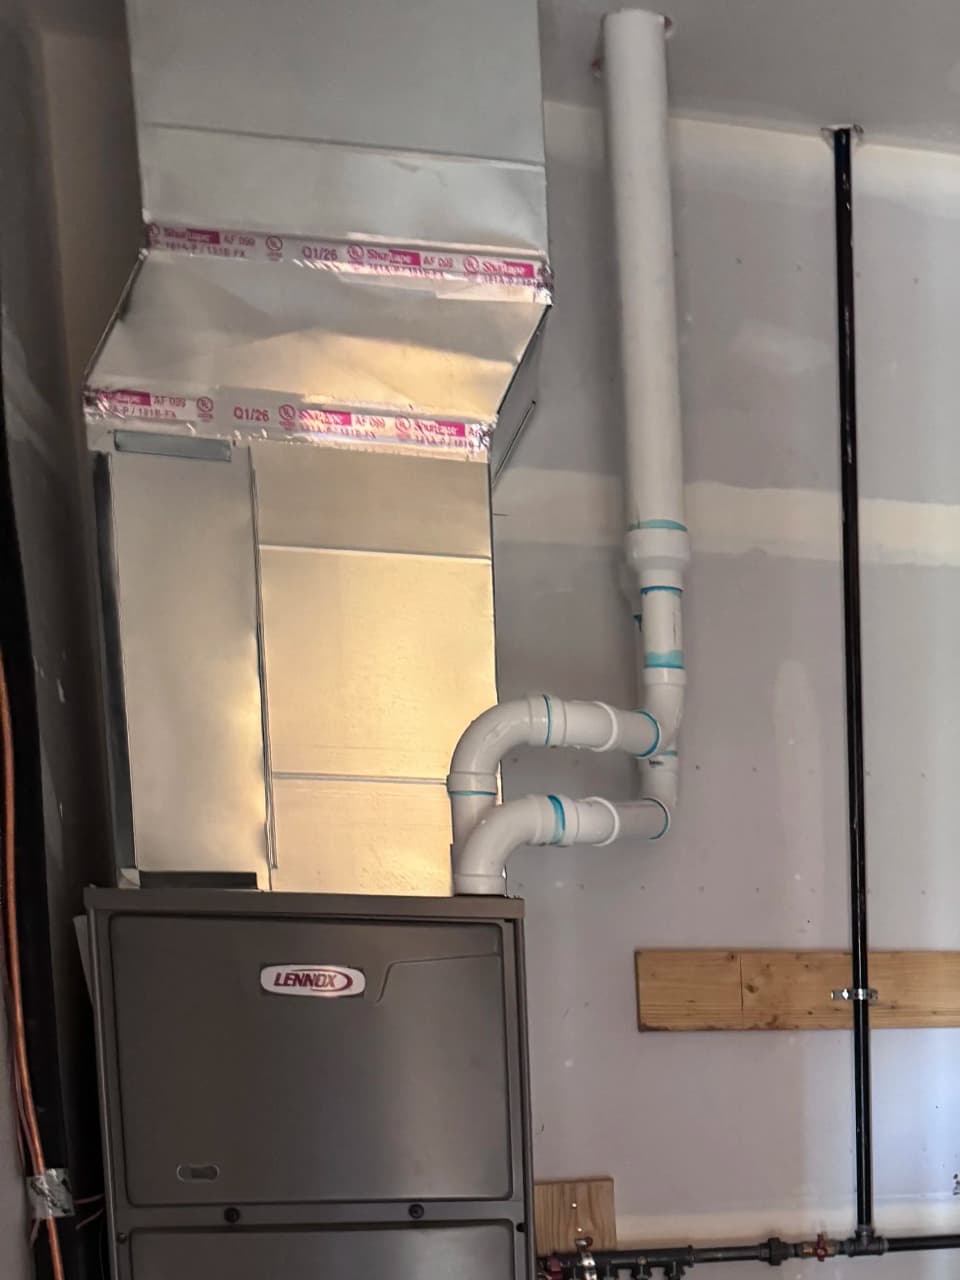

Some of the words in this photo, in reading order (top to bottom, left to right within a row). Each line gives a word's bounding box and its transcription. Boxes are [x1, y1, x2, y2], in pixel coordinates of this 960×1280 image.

[302, 246, 338, 261] Q1/26
[233, 407, 270, 422] Q1/26
[273, 972, 336, 988] LENNOX
